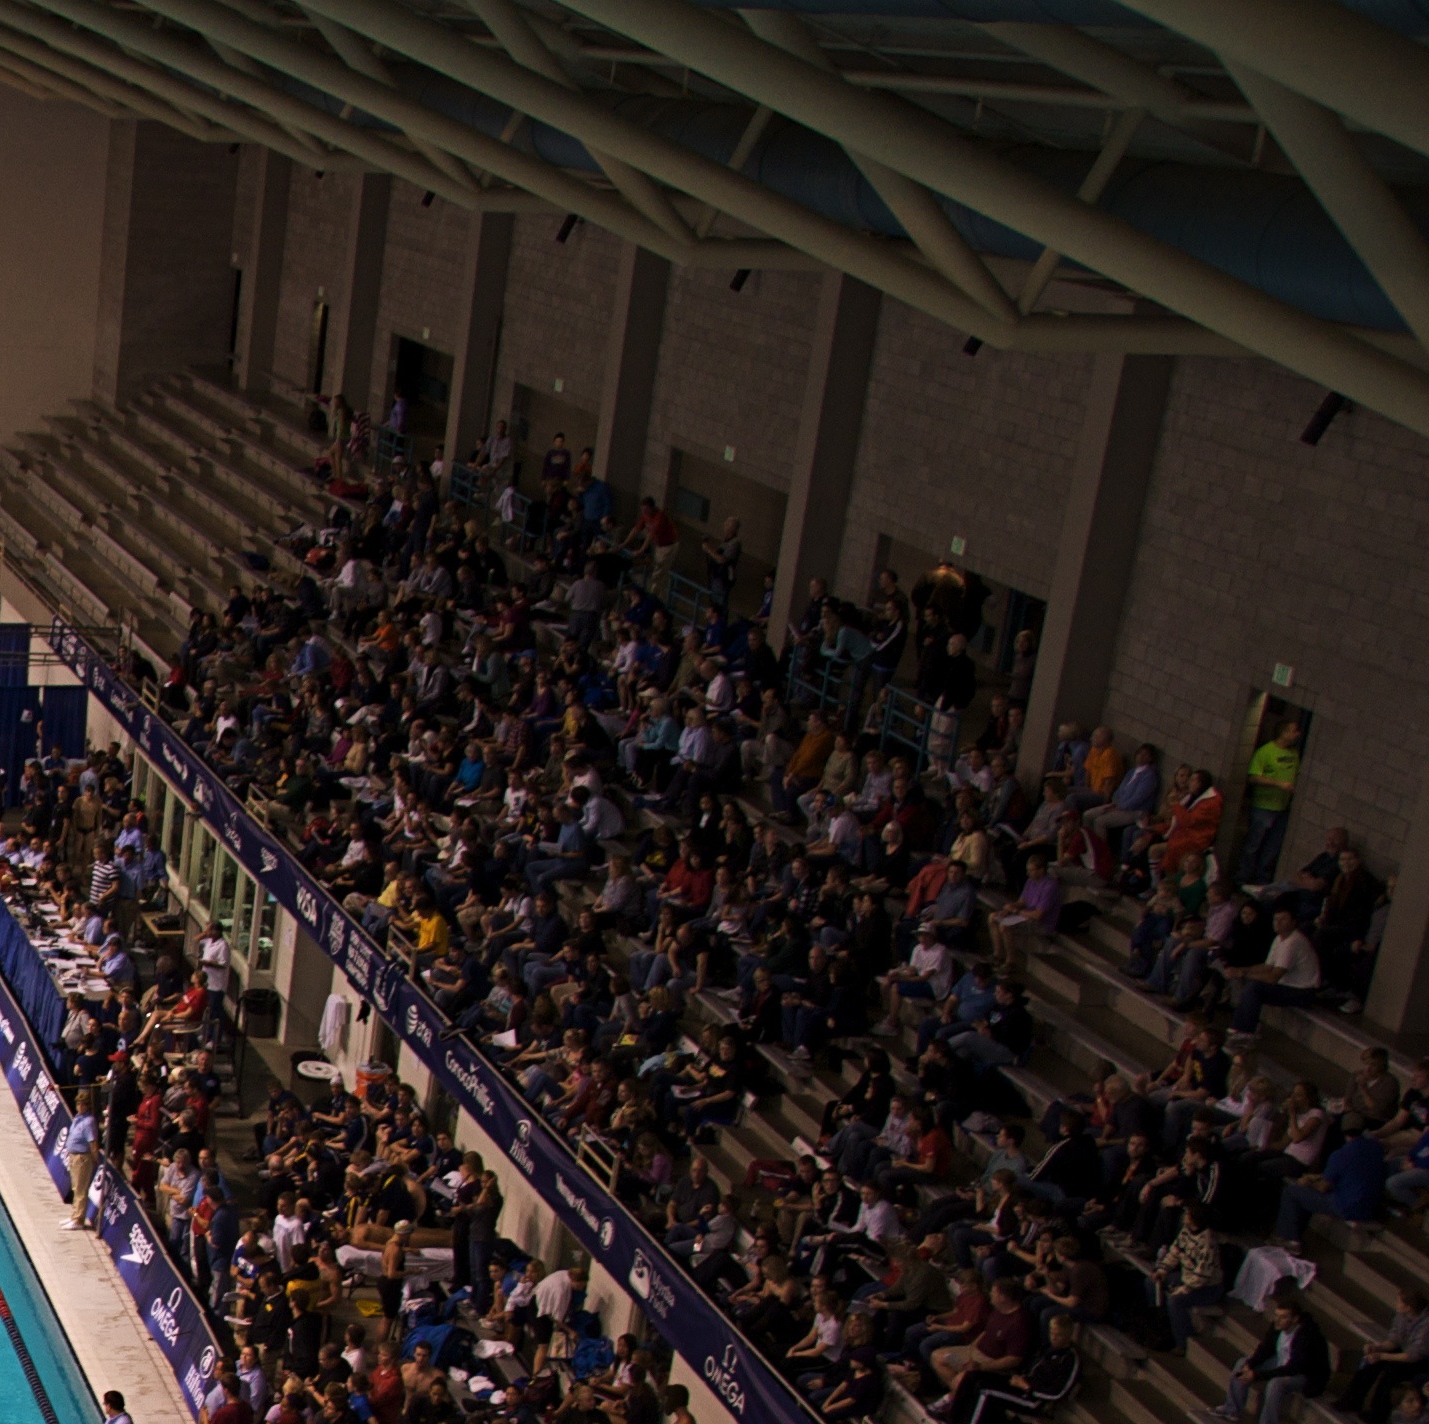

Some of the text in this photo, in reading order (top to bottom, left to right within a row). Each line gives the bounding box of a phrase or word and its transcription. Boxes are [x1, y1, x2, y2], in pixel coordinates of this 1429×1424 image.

[296, 880, 317, 927] VISA
[509, 1139, 535, 1175] Hilton
[129, 1223, 155, 1266] speedo
[652, 1270, 675, 1308] Myrtha
[151, 1297, 180, 1347] OMEGA
[184, 1363, 205, 1410] Hilton
[704, 1355, 745, 1415] OMEGA
